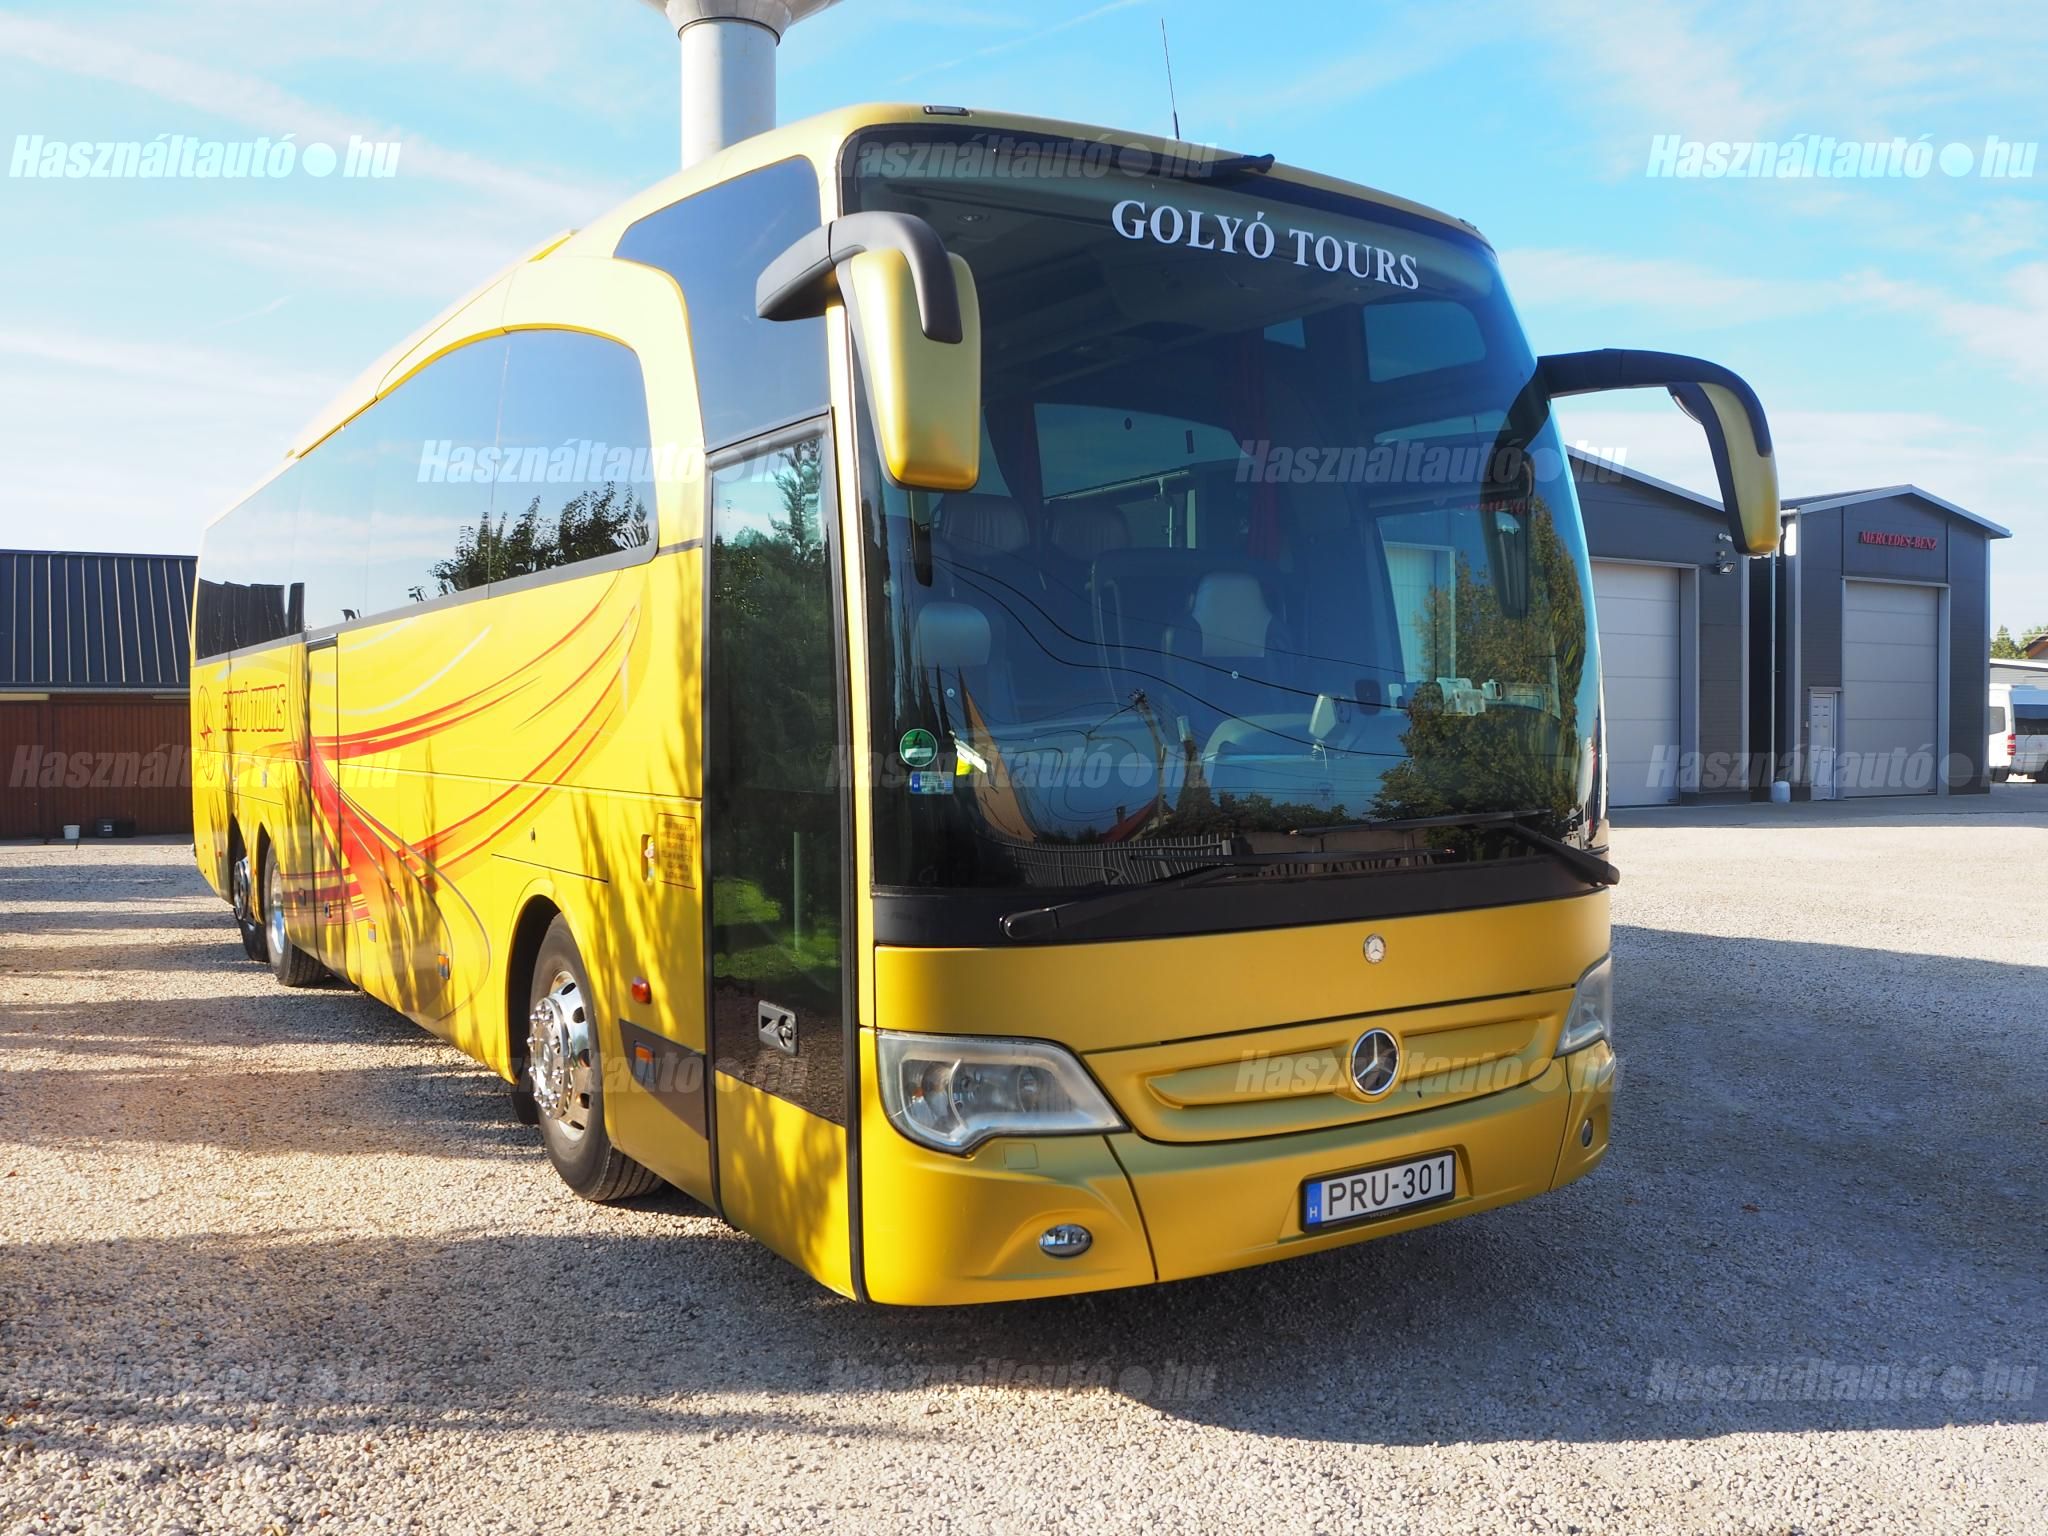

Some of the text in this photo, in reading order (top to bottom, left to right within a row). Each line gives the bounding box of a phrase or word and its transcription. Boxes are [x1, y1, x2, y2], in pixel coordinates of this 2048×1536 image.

[1112, 200, 1419, 289] GOLYÓ TOURS
[1861, 531, 1937, 550] MERCEDES-BENZ
[1309, 1160, 1446, 1218] H PRU-301
